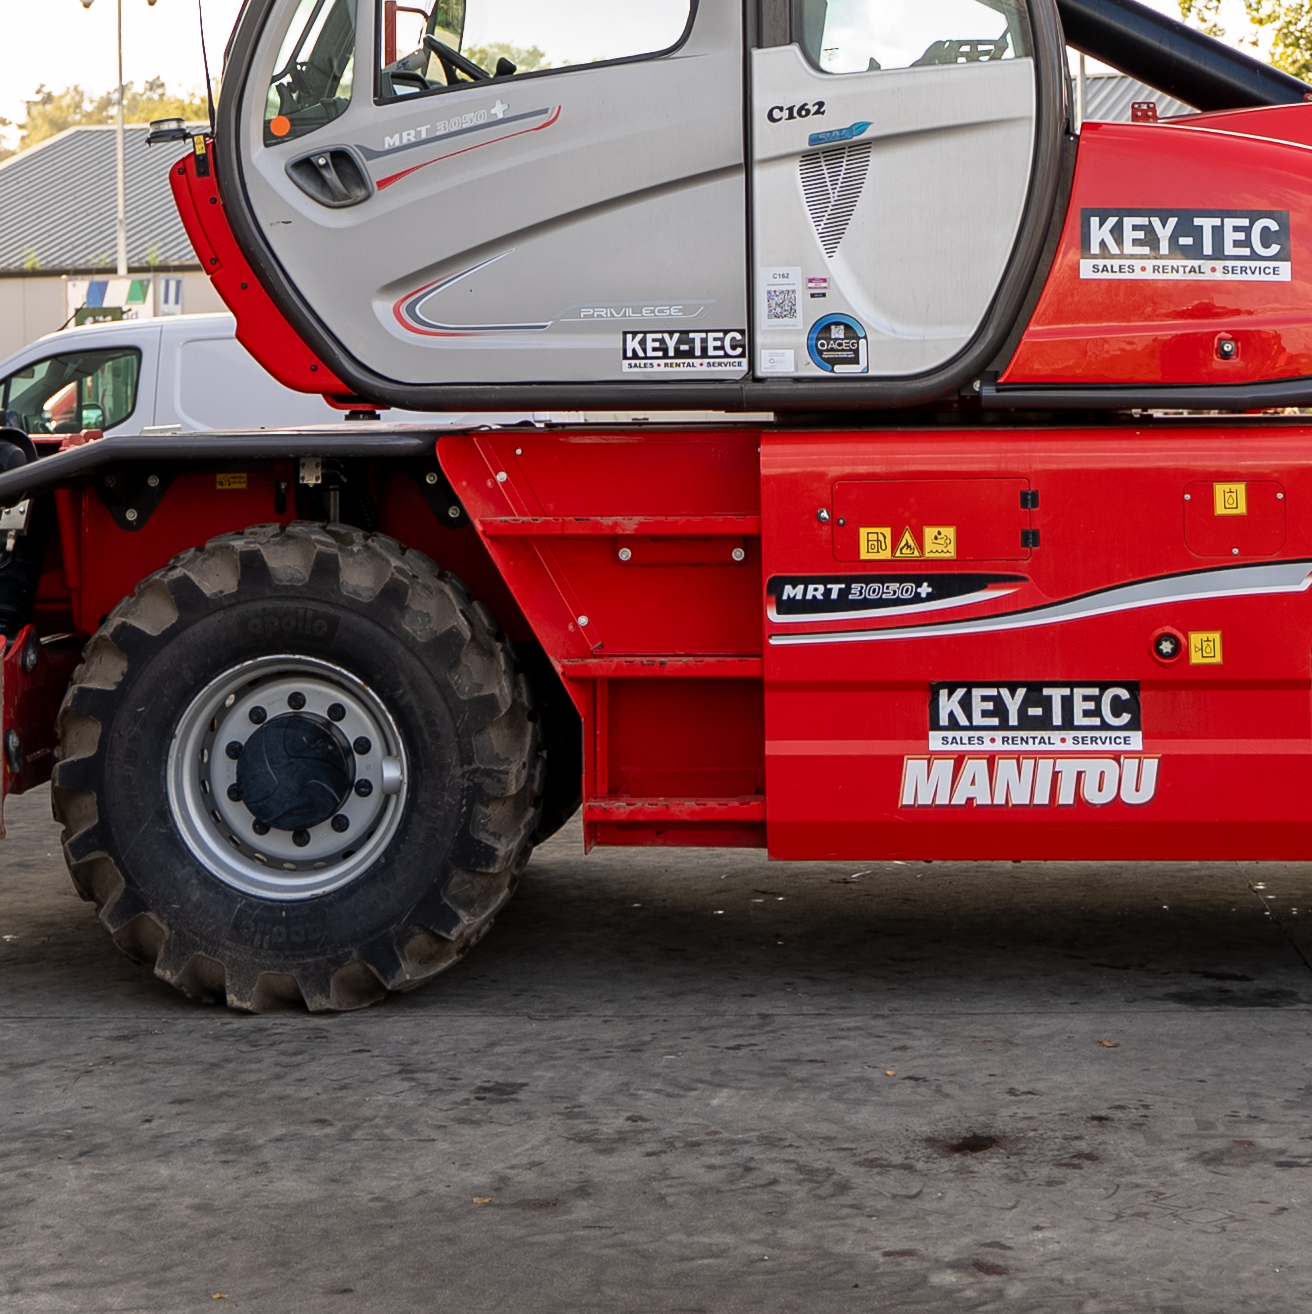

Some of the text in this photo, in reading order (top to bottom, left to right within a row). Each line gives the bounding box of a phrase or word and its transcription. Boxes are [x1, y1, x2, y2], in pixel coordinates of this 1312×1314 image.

[766, 100, 826, 124] C162
[383, 124, 431, 149] MRT
[1089, 216, 1282, 257] KEY-TEC
[1091, 264, 1281, 276] SALES RENTAL SERVICE
[580, 306, 684, 318] PRIVILEGE
[625, 331, 743, 358] KEY-TEC
[627, 360, 743, 369] SALES RENTAL SERVICE
[781, 583, 846, 601] MRT
[938, 687, 1132, 727] KEY-TEC
[940, 735, 1132, 746] SALES RENTAL SERVICE
[898, 754, 1162, 808] MANITOU
